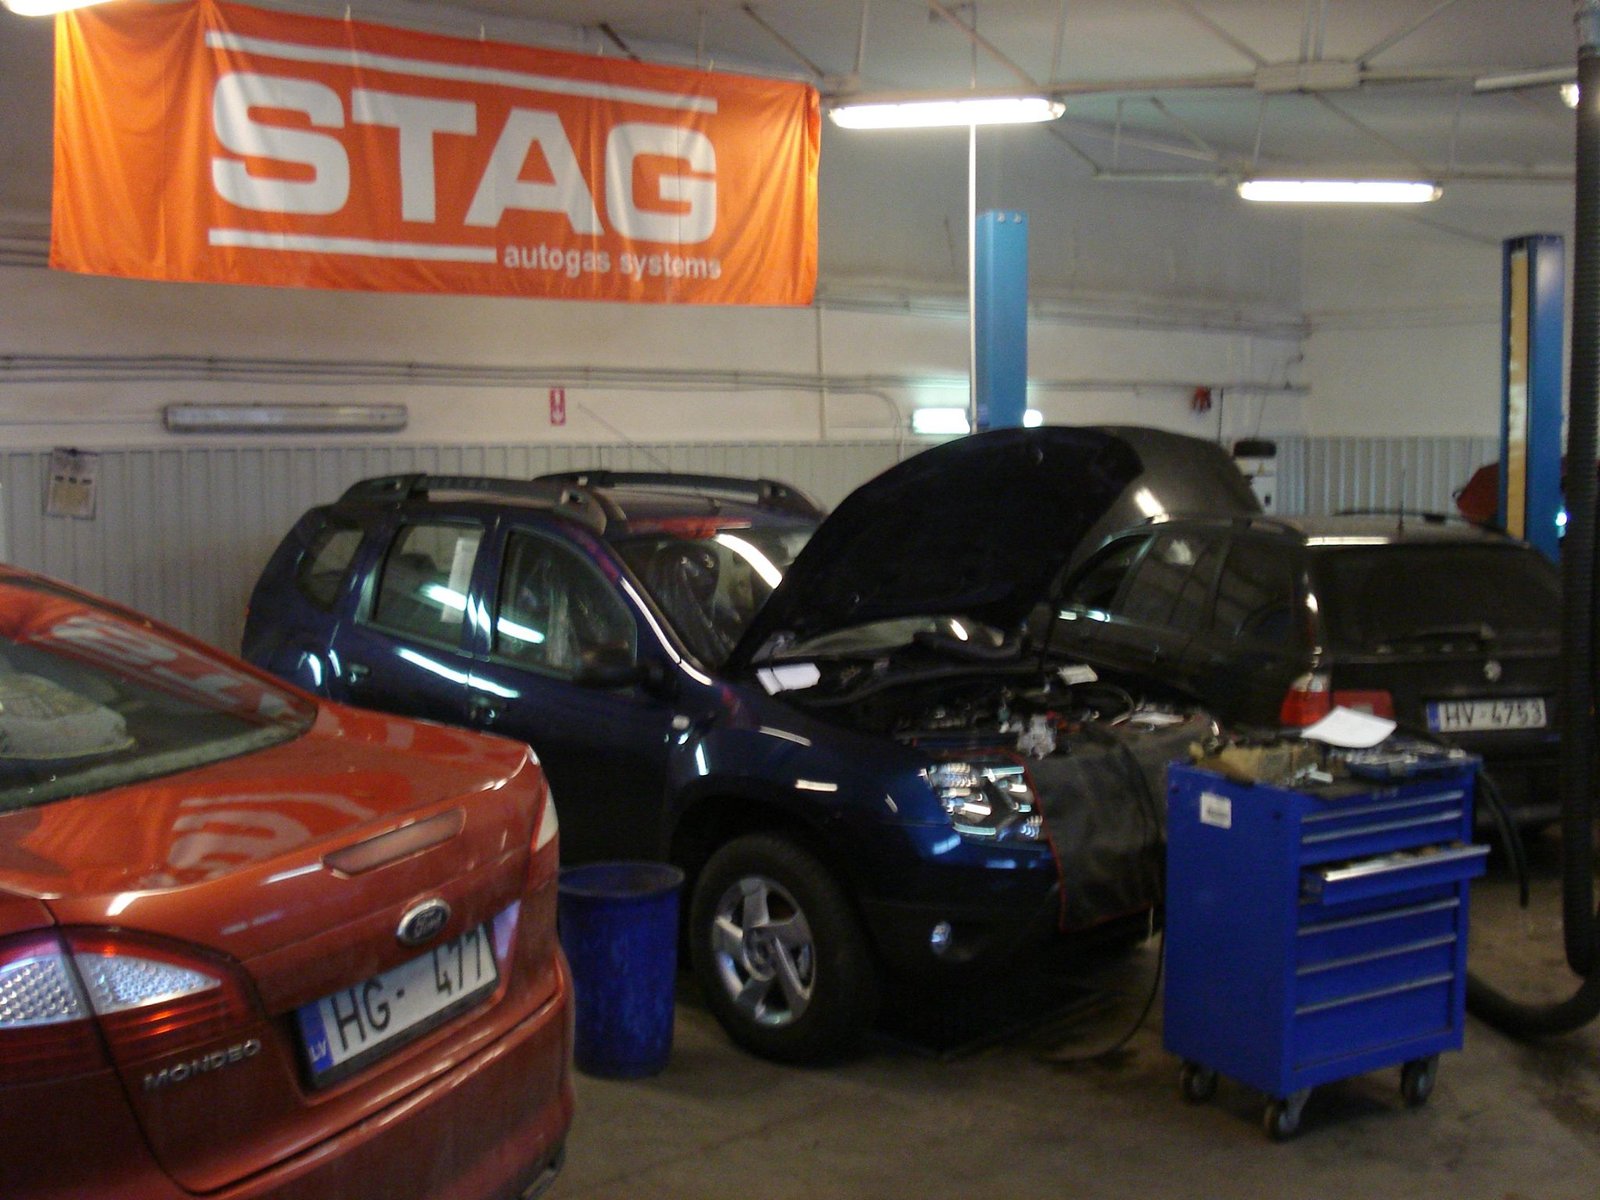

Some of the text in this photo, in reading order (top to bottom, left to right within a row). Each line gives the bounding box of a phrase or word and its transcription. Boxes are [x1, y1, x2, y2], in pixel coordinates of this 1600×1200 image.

[211, 71, 718, 245] STAG
[504, 243, 722, 282] autogas systems
[143, 1039, 262, 1090] MONDEO
[311, 1040, 328, 1058] LV
